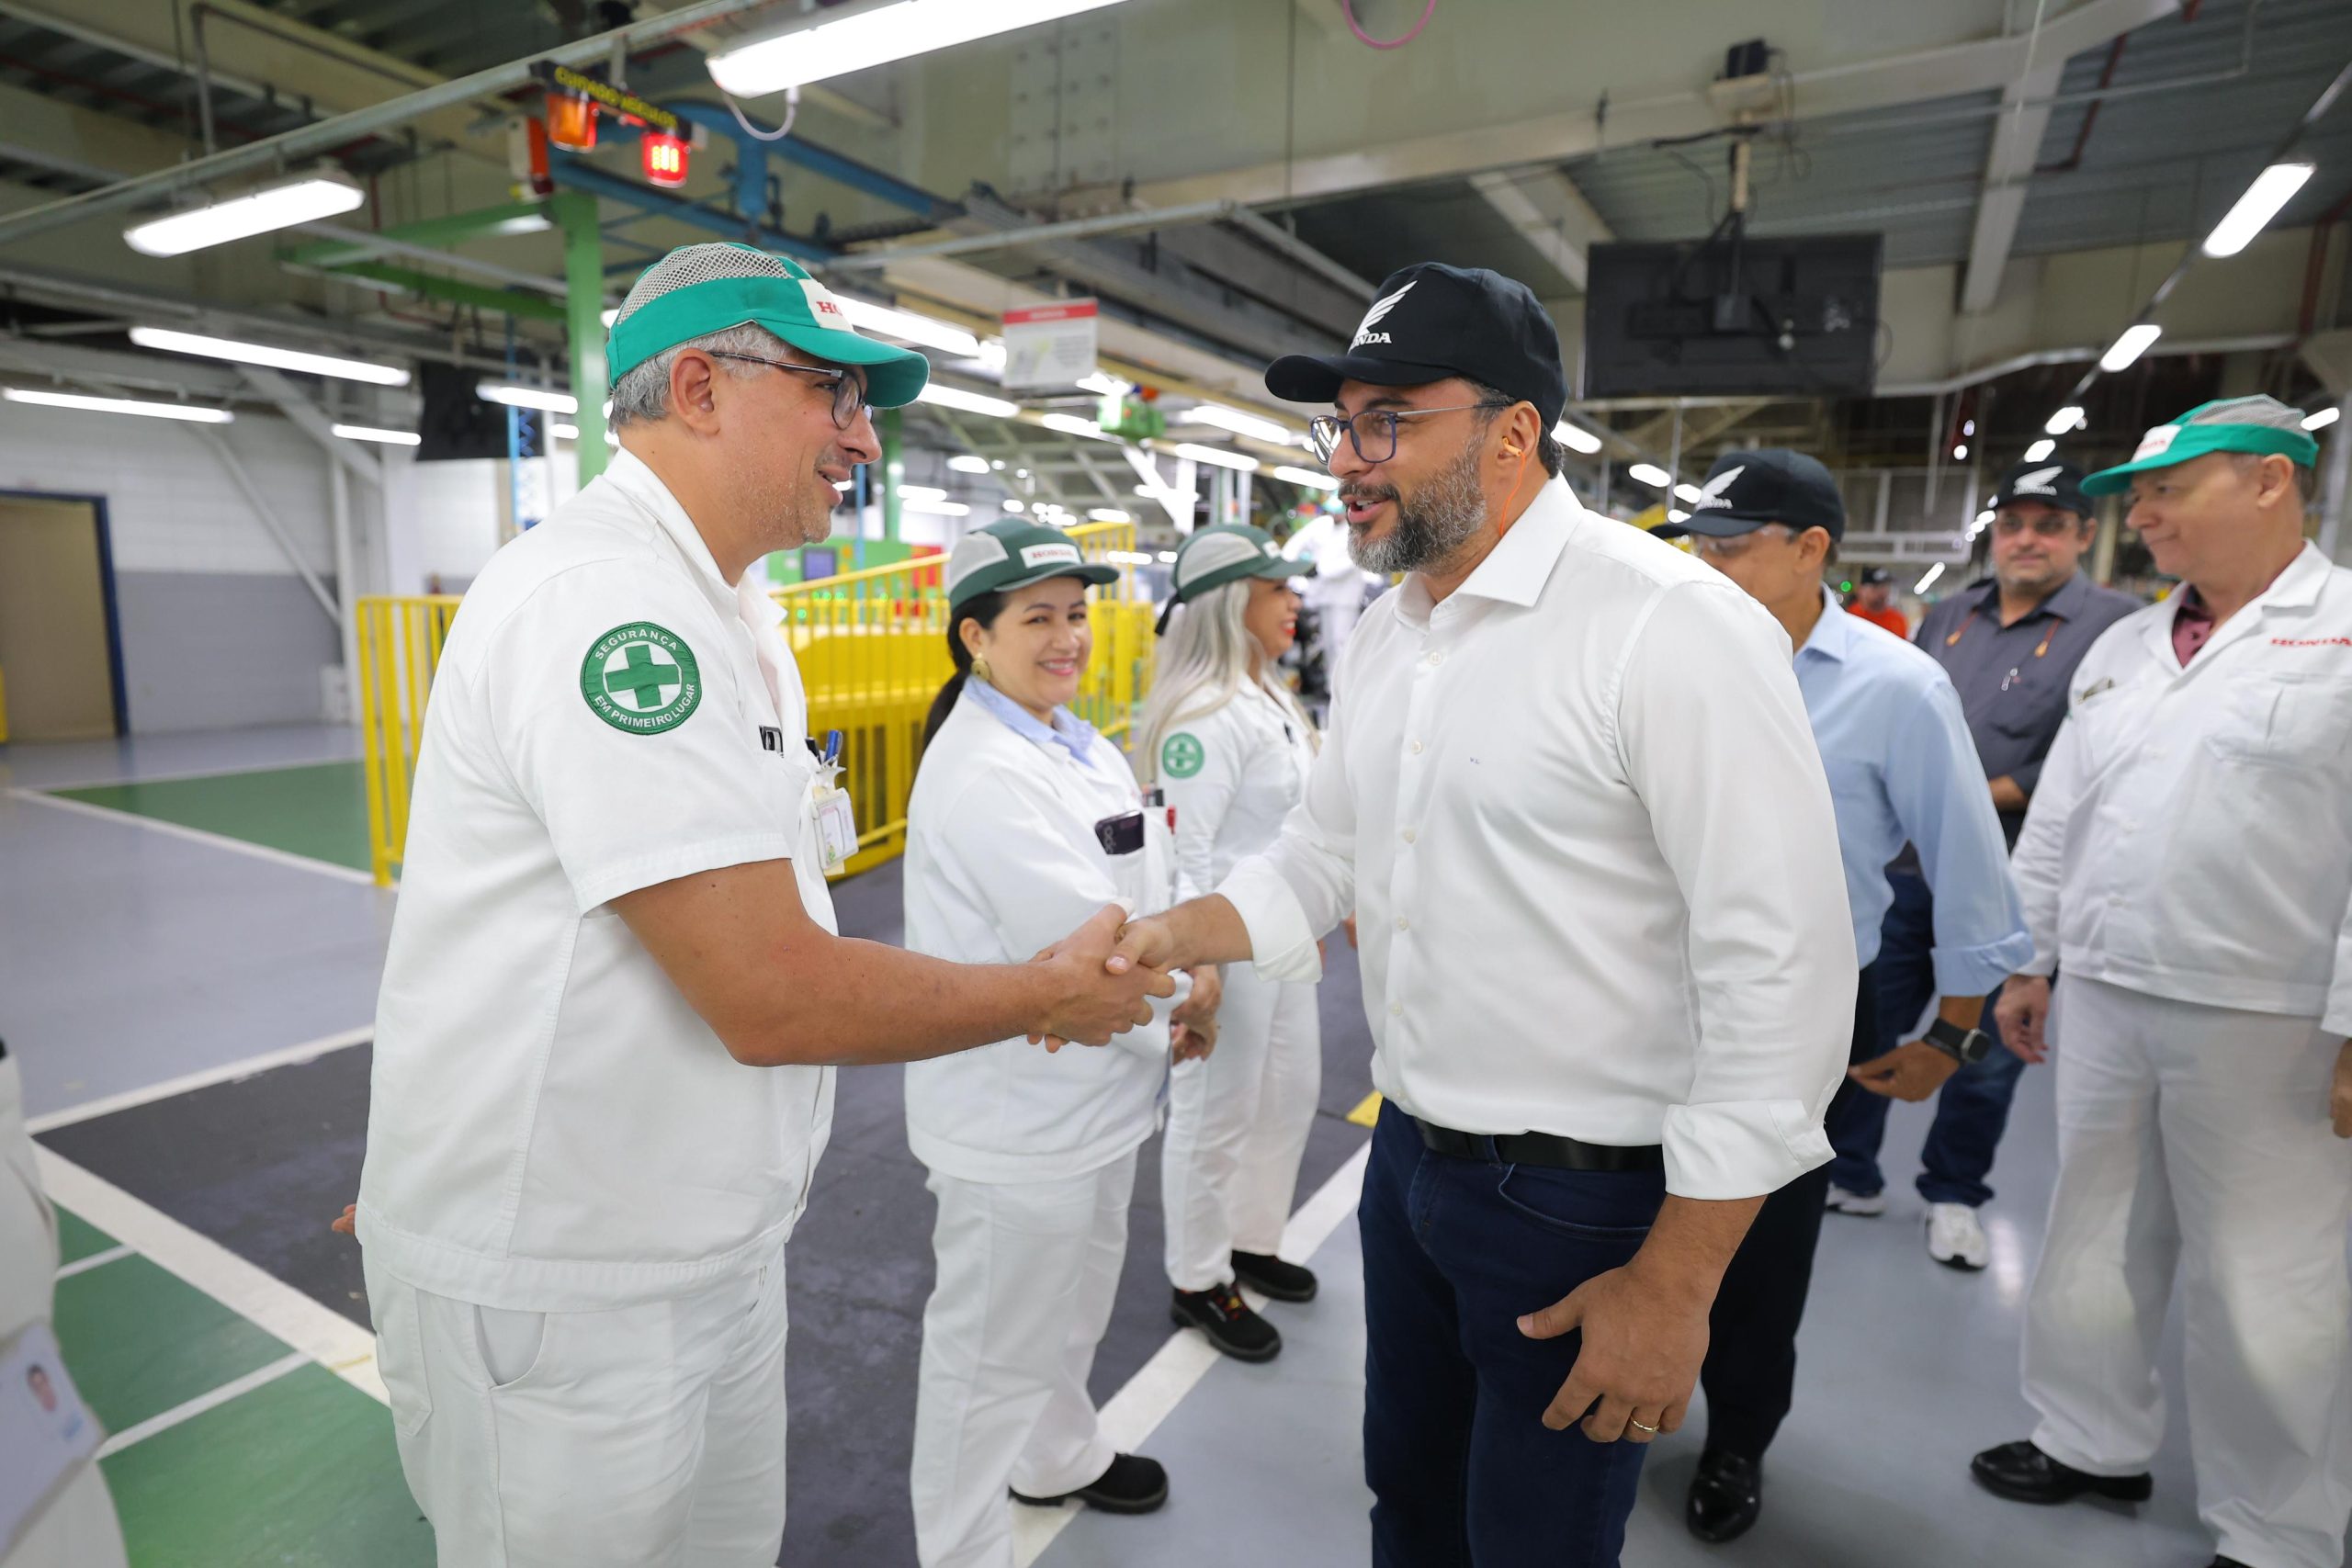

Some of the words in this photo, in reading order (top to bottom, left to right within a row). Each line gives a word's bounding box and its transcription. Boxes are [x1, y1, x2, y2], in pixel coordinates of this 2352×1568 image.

[594, 628, 678, 660] SEGURANÇA
[594, 694, 612, 713] EM
[610, 709, 673, 728] PRIMEIRO
[671, 683, 695, 718] LUGAR
